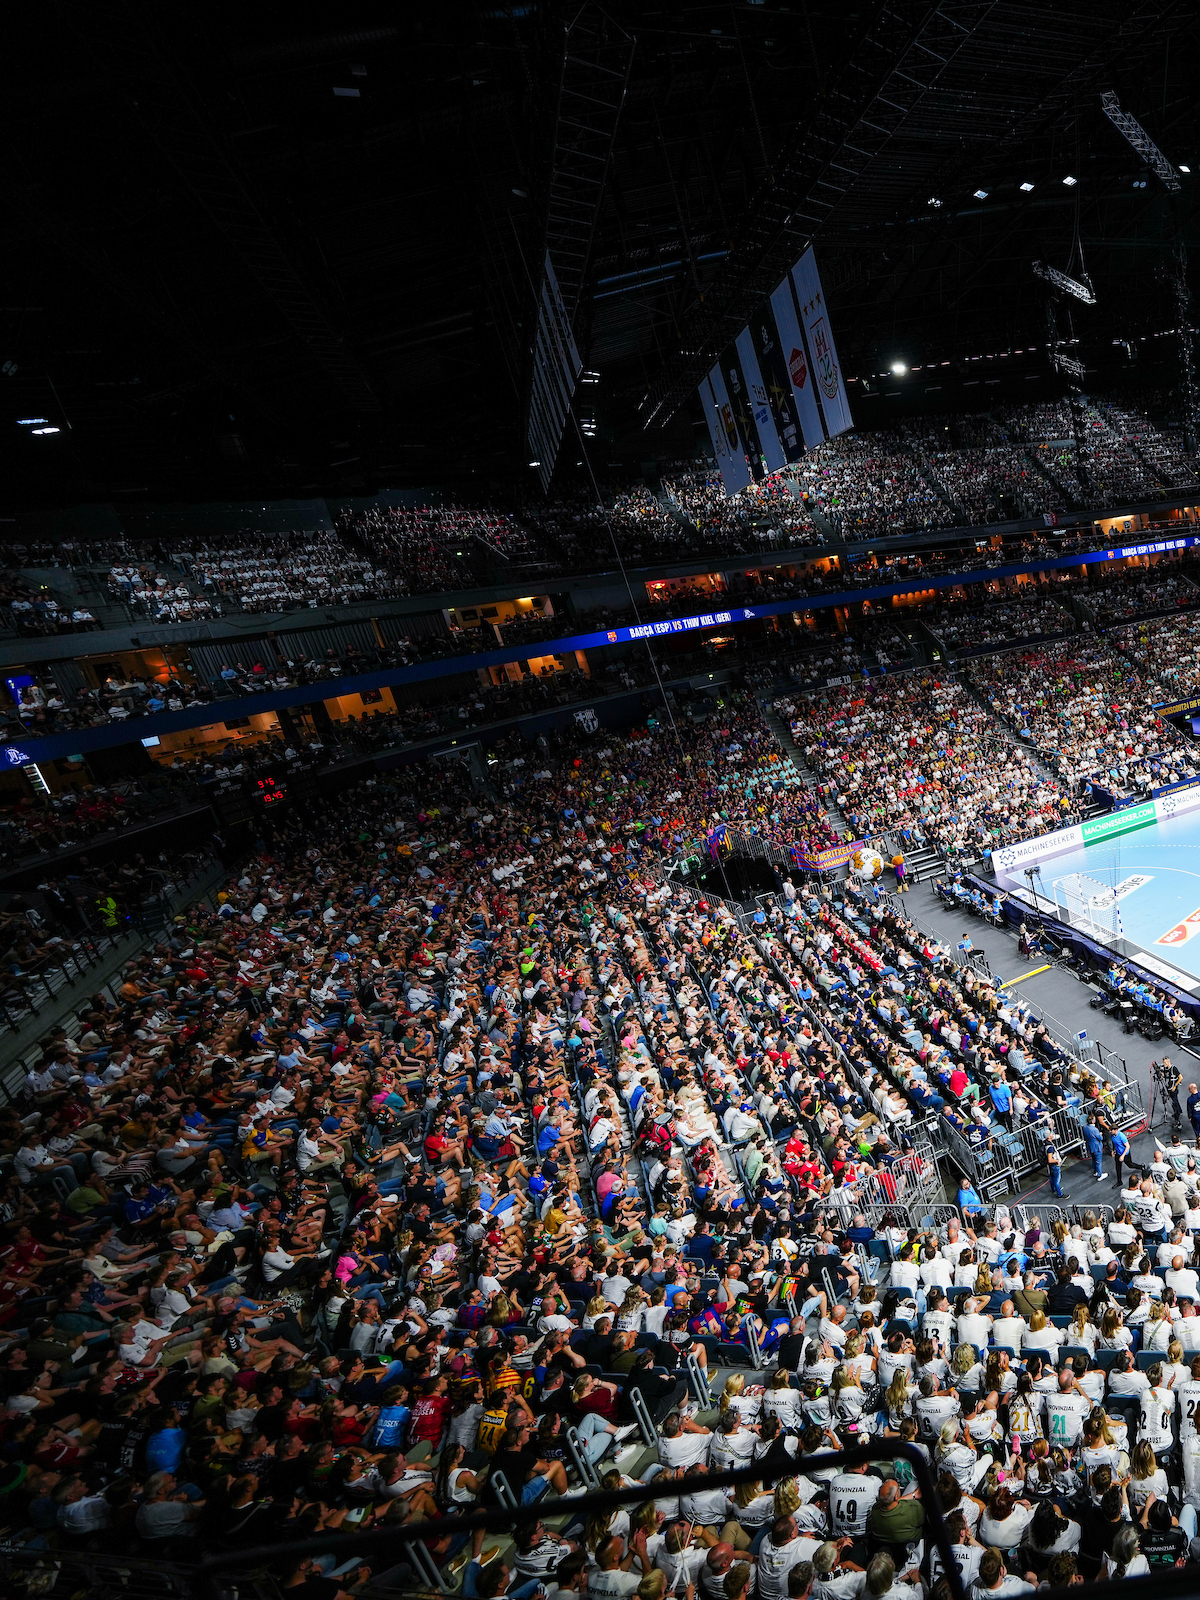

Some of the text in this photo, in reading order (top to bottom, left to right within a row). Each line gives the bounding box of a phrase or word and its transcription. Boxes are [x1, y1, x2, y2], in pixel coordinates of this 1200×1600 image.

[629, 612, 731, 638] BARÇA (ESP) VS THW KIEL (GER)
[258, 780, 264, 788] 9
[1084, 807, 1154, 835] MACHINESEEKER.COM
[819, 845, 854, 861] MERITXELL
[1017, 833, 1075, 857] MACHINESEEKER
[1164, 930, 1182, 942] MOL
[527, 1310, 537, 1327] 2
[378, 1328, 388, 1344] 3
[924, 1328, 940, 1342] 13
[524, 1376, 536, 1398] 6
[411, 1416, 419, 1436] 7
[923, 1417, 932, 1433] 6
[1011, 1412, 1029, 1432] 21
[1052, 1415, 1066, 1434] 21
[376, 1428, 384, 1446] 7
[481, 1426, 496, 1446] 24
[836, 1500, 857, 1522] 49
